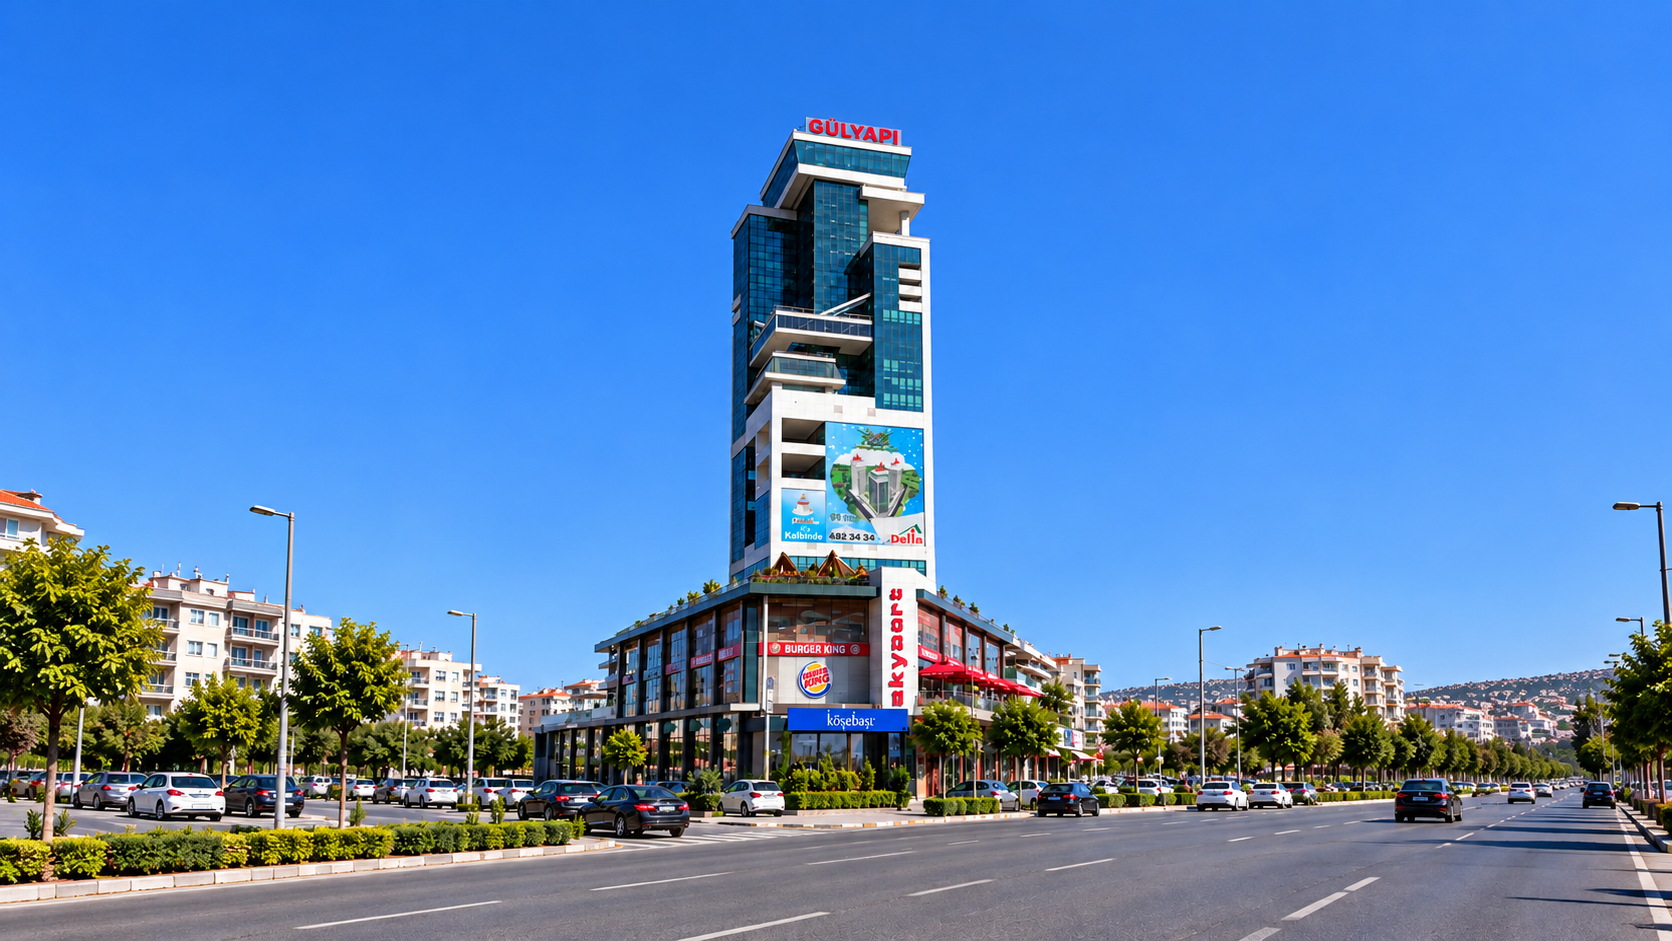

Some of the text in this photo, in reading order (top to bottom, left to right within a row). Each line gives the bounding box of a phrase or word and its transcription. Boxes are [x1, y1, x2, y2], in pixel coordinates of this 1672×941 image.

[809, 117, 898, 145] GÜLYAPI
[785, 644, 845, 654] BURGER KING
